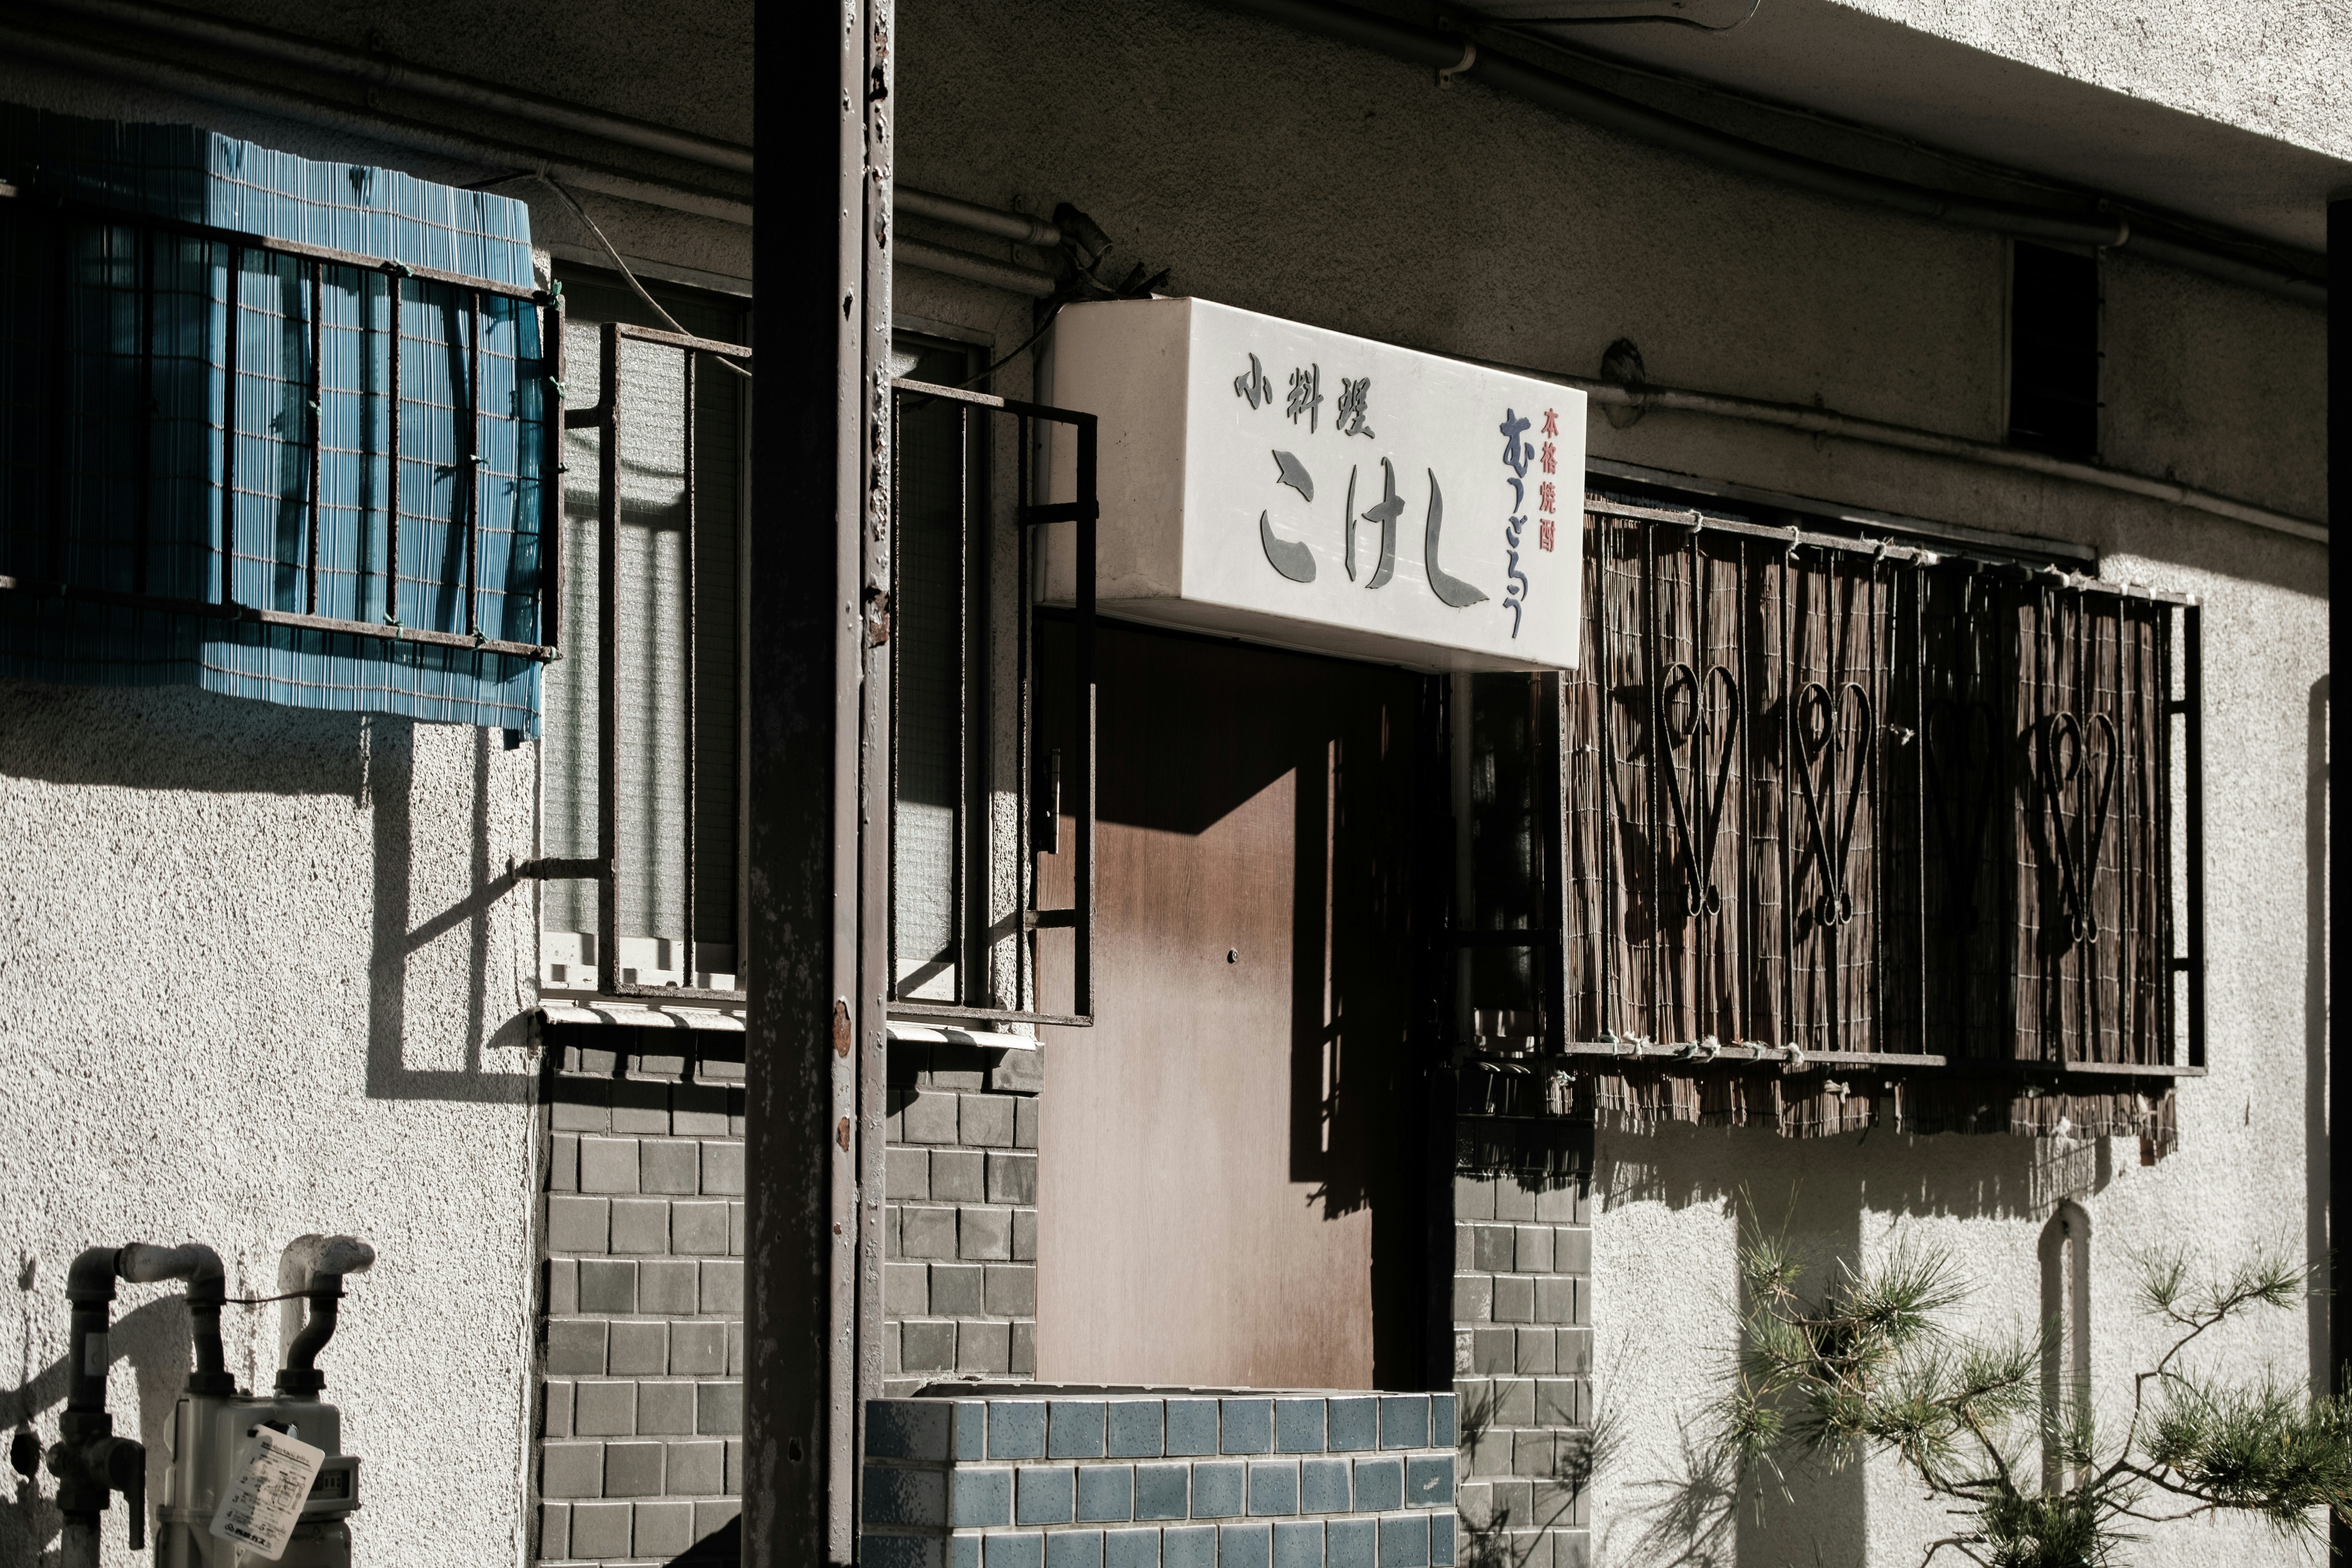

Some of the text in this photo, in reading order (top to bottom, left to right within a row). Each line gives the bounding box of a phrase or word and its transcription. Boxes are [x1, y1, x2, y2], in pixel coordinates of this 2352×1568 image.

[1234, 353, 1375, 439] 小料理
[1260, 450, 1489, 608] こけし
[1539, 408, 1559, 553] 本格焼酎
